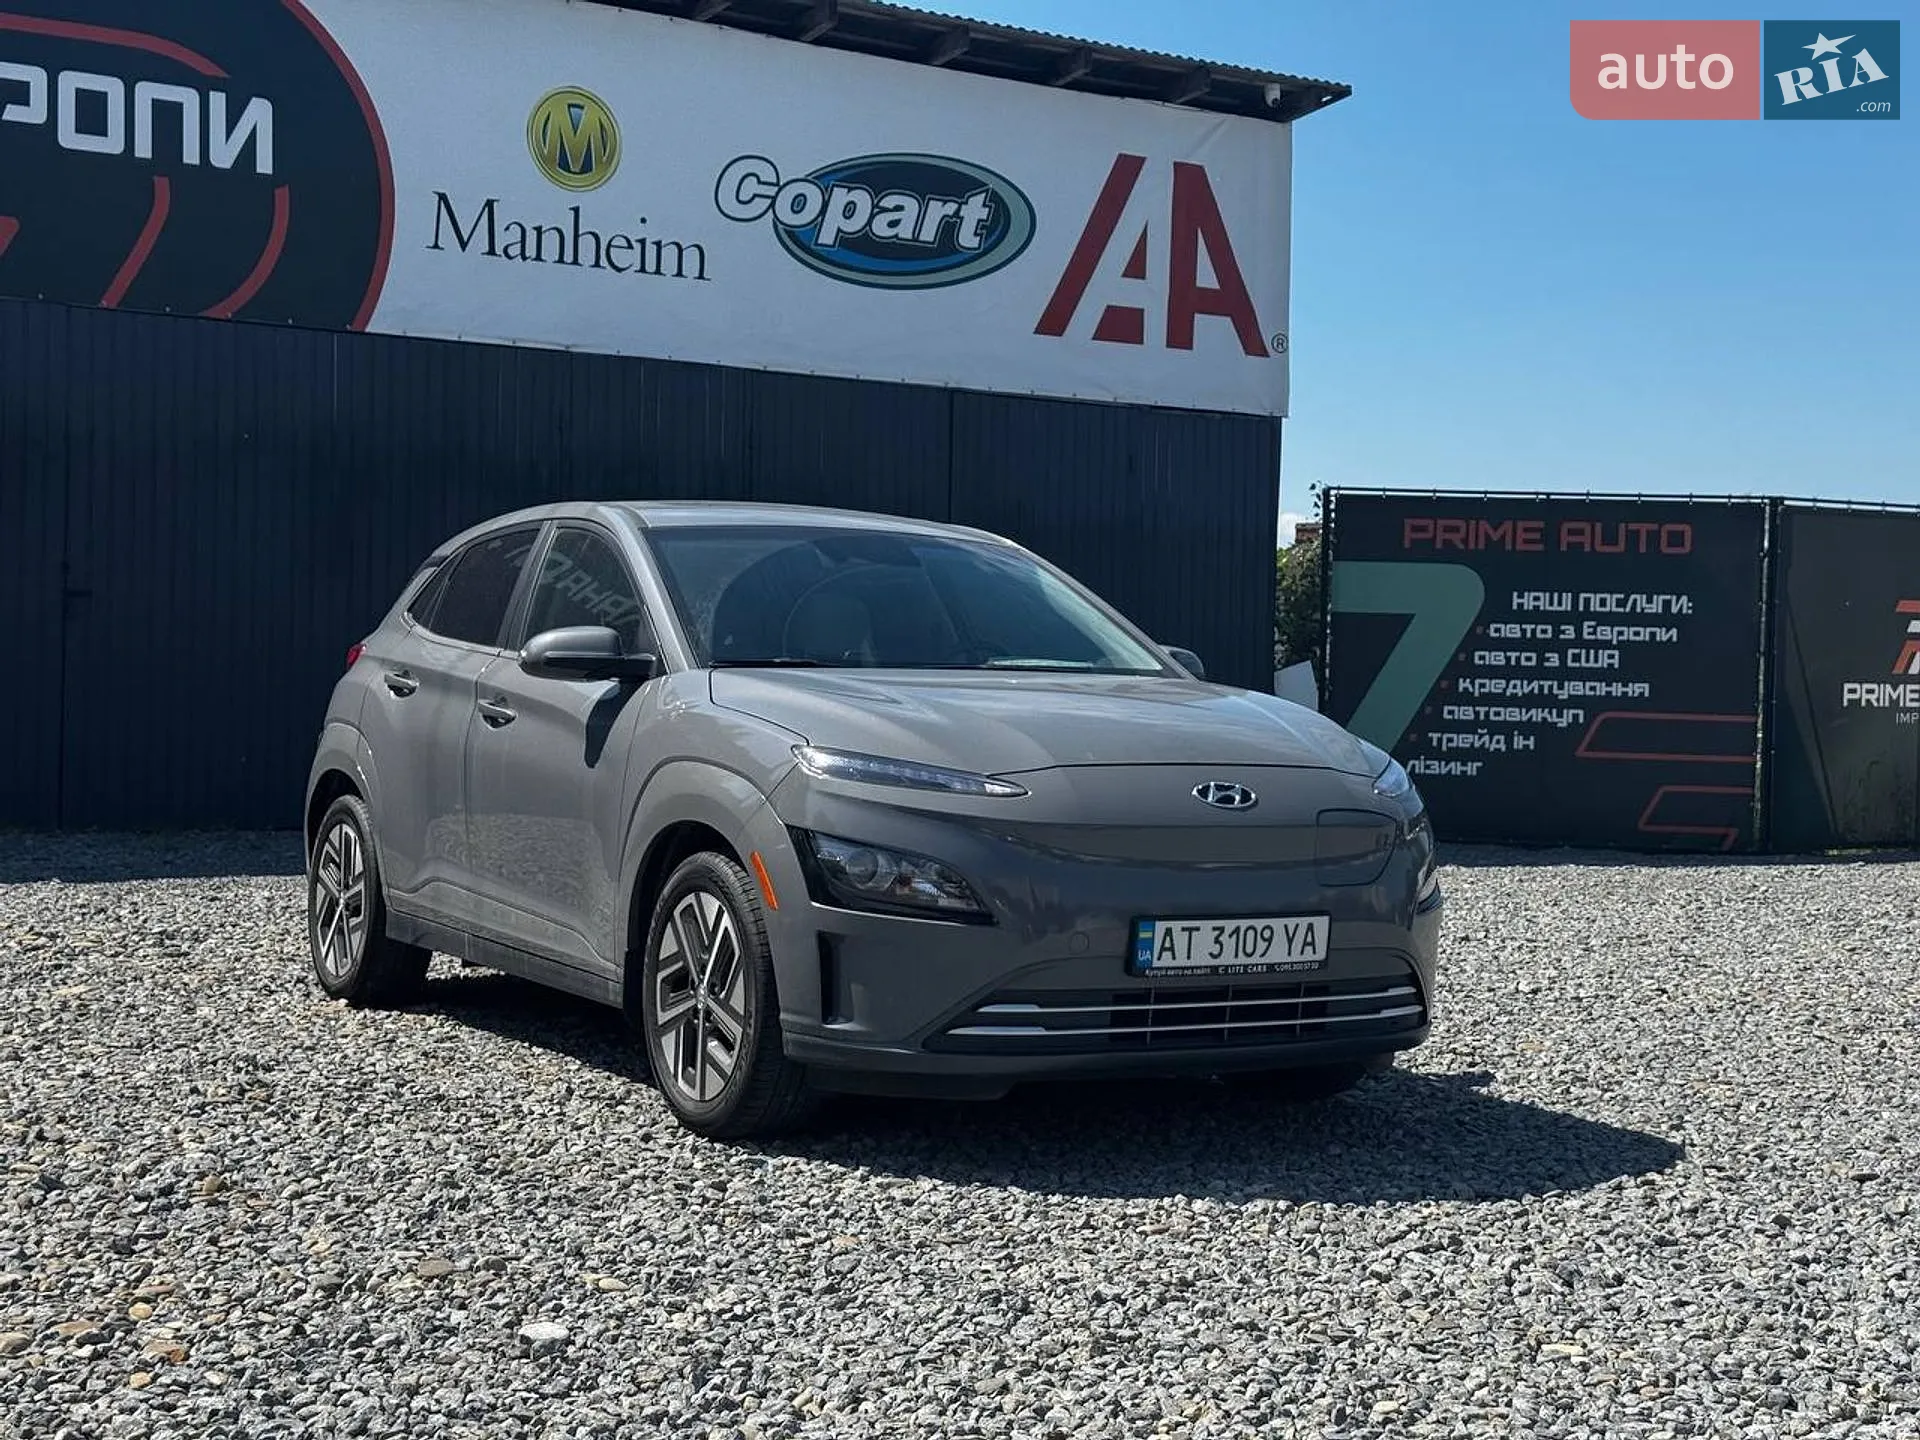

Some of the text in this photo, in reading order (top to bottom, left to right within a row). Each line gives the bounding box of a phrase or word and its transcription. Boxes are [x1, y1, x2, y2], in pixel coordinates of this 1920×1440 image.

[714, 153, 1001, 252] Copart
[425, 190, 711, 282] Manheim
[1403, 517, 1693, 554] PRIME AUTO
[1511, 591, 1693, 615] НАШІ ПОСЛУГИ:
[1489, 622, 1553, 639] авто
[1559, 624, 1576, 640] з
[1473, 648, 1620, 669] авто з США
[1457, 677, 1651, 700] кредитування
[1842, 682, 1920, 708] PRIME
[1442, 704, 1585, 728] автовикуп
[1427, 728, 1535, 751] трейд ін
[1407, 755, 1484, 777] лізинг
[1157, 922, 1317, 962] AT 3109 YA
[1138, 950, 1152, 961] UA
